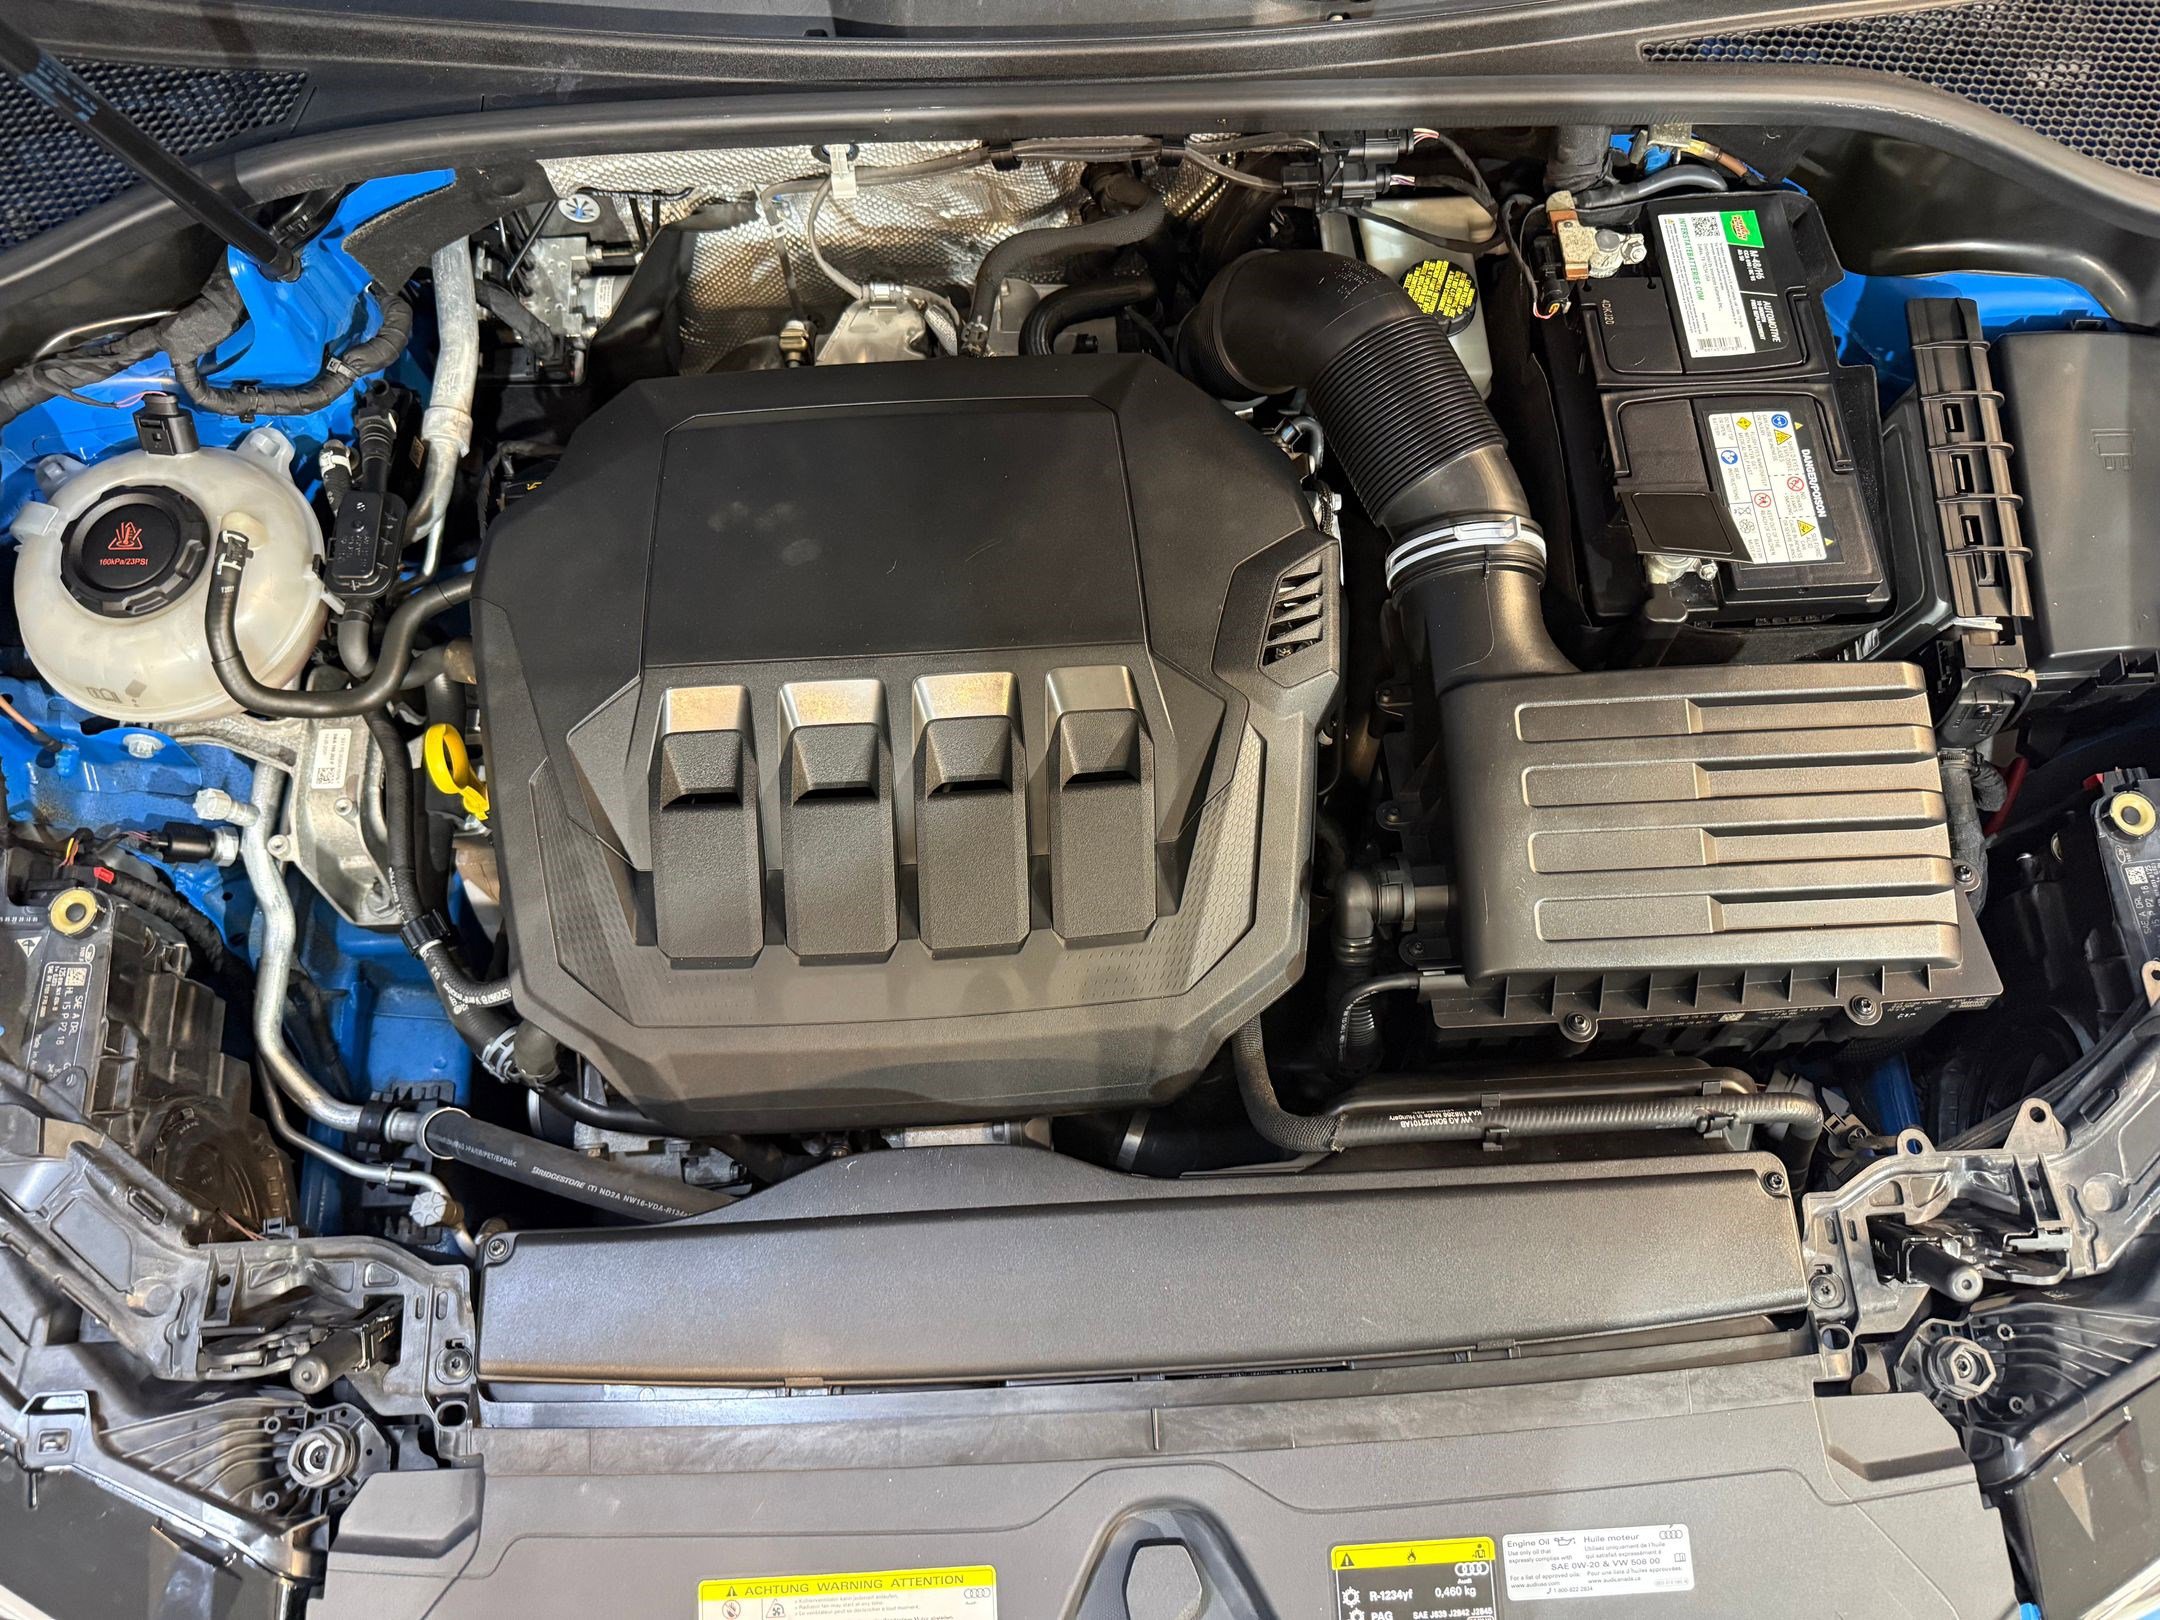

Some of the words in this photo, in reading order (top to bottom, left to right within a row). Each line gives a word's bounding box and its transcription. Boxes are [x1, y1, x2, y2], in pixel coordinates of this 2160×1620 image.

[1677, 217, 1706, 301] INTERSTATEBATTERIES.COM
[1748, 249, 1765, 279] M-48/H6
[1749, 299, 1757, 309] FREE
[1752, 309, 1766, 340] REPLACEMENT
[1761, 300, 1781, 343] AUTOMOTIVE
[1737, 432, 1747, 451] MEDICAL
[1767, 438, 1778, 461] BLINDNESS
[1781, 445, 1793, 472] EXPLOSIVE
[1755, 457, 1768, 486] IMMEDIATELY
[1800, 448, 1826, 517] DANGER/POISON
[1752, 538, 1763, 559] BATTERY
[1764, 532, 1776, 555] CHILDREN
[1791, 534, 1803, 558] BLINDNESS
[1810, 532, 1821, 557] SULFURIC
[99, 557, 148, 565] 160kPa/23PSI
[2135, 896, 2143, 908] DRL
[2146, 898, 2154, 908] P2
[2141, 920, 2151, 934] SAE
[64, 986, 72, 997] HL
[61, 1000, 71, 1010] 15
[72, 994, 83, 1009] SAE
[57, 1020, 67, 1032] P2
[67, 1020, 78, 1036] DRL
[33, 1032, 41, 1048] Made
[530, 1165, 587, 1189] BRIDGESTONE
[598, 1187, 621, 1199] ND2A
[1506, 1538, 1536, 1548] Engine
[1538, 1537, 1550, 1545] Oil
[1583, 1534, 1604, 1543] Huile
[1607, 1533, 1640, 1542] moteur
[1519, 1549, 1531, 1557] only
[1596, 1551, 1617, 1559] satisfait
[1618, 1549, 1657, 1558] expressément
[1605, 1543, 1639, 1552] uniquement
[1508, 1557, 1534, 1565] expressly
[1535, 1555, 1559, 1563] complies
[1551, 1562, 1569, 1571] SAE
[1571, 1560, 1600, 1570] 0W-20
[1601, 1559, 1610, 1567] &
[1611, 1558, 1629, 1567] VW
[1630, 1557, 1647, 1566] 508
[1648, 1556, 1660, 1565] 00
[1541, 1571, 1568, 1580] approved
[744, 1583, 809, 1595] ACHTUNG
[816, 1579, 883, 1591] WARNING
[890, 1574, 964, 1587] ATTENTION
[1368, 1588, 1413, 1604] R-1234yf
[1434, 1585, 1462, 1600] 0,460
[1463, 1584, 1477, 1598] kg
[1370, 1610, 1393, 1620] PAG
[1412, 1611, 1428, 1619] SAE
